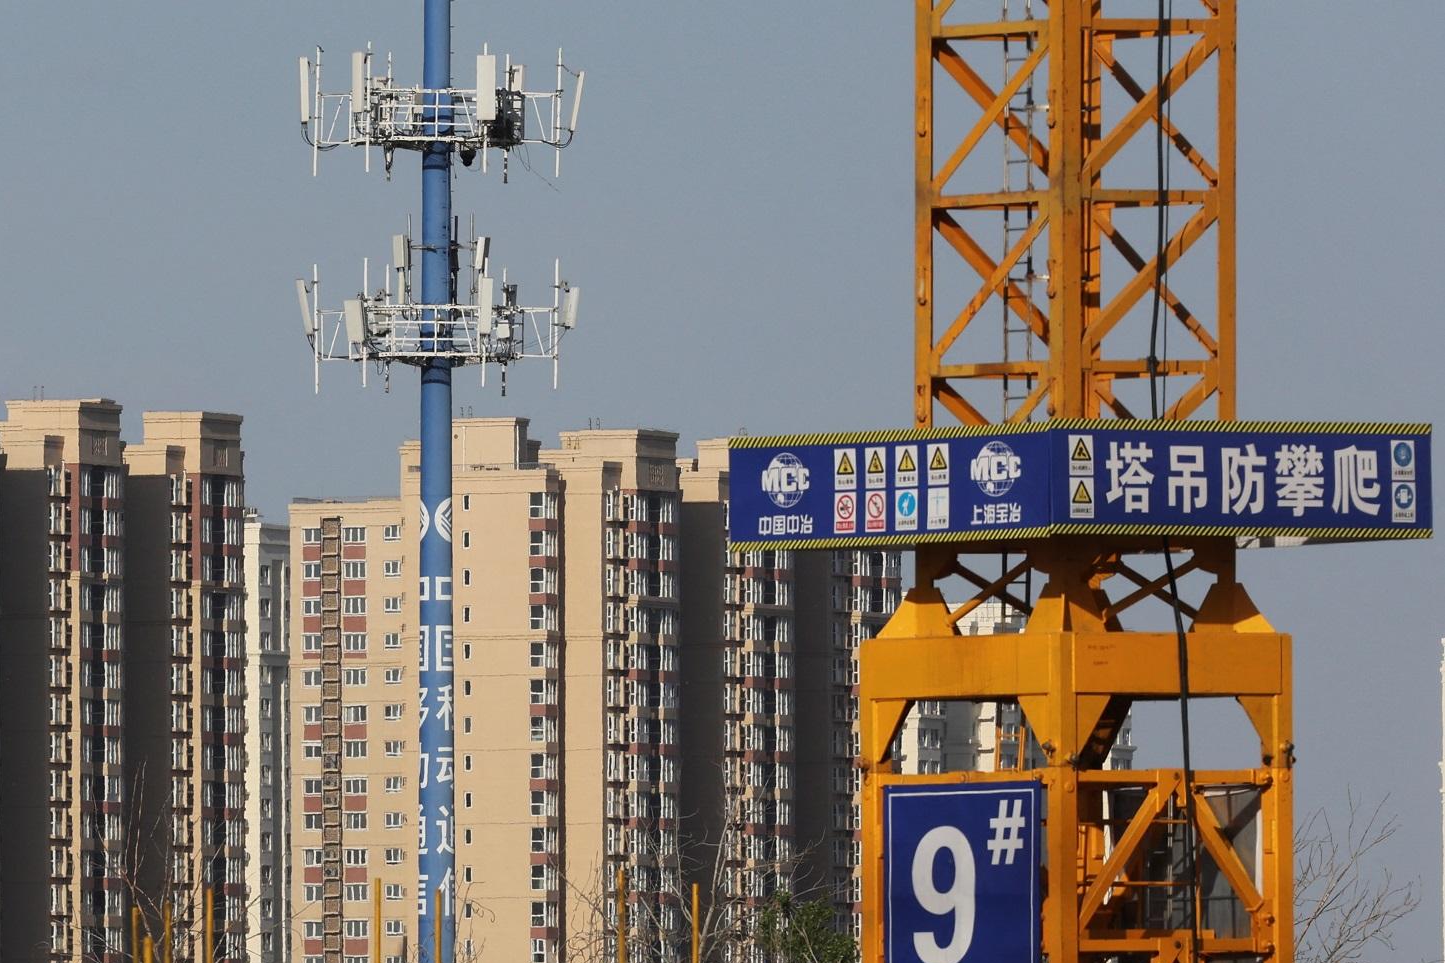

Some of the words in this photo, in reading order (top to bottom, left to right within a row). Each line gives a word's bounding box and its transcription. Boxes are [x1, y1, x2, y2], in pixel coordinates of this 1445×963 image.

[761, 467, 810, 492] MCC
[970, 455, 1022, 481] MCC
[1105, 440, 1382, 516] 塔吊防攀爬
[758, 514, 813, 536] 中国中冶
[970, 502, 1022, 526] 上海宝冶
